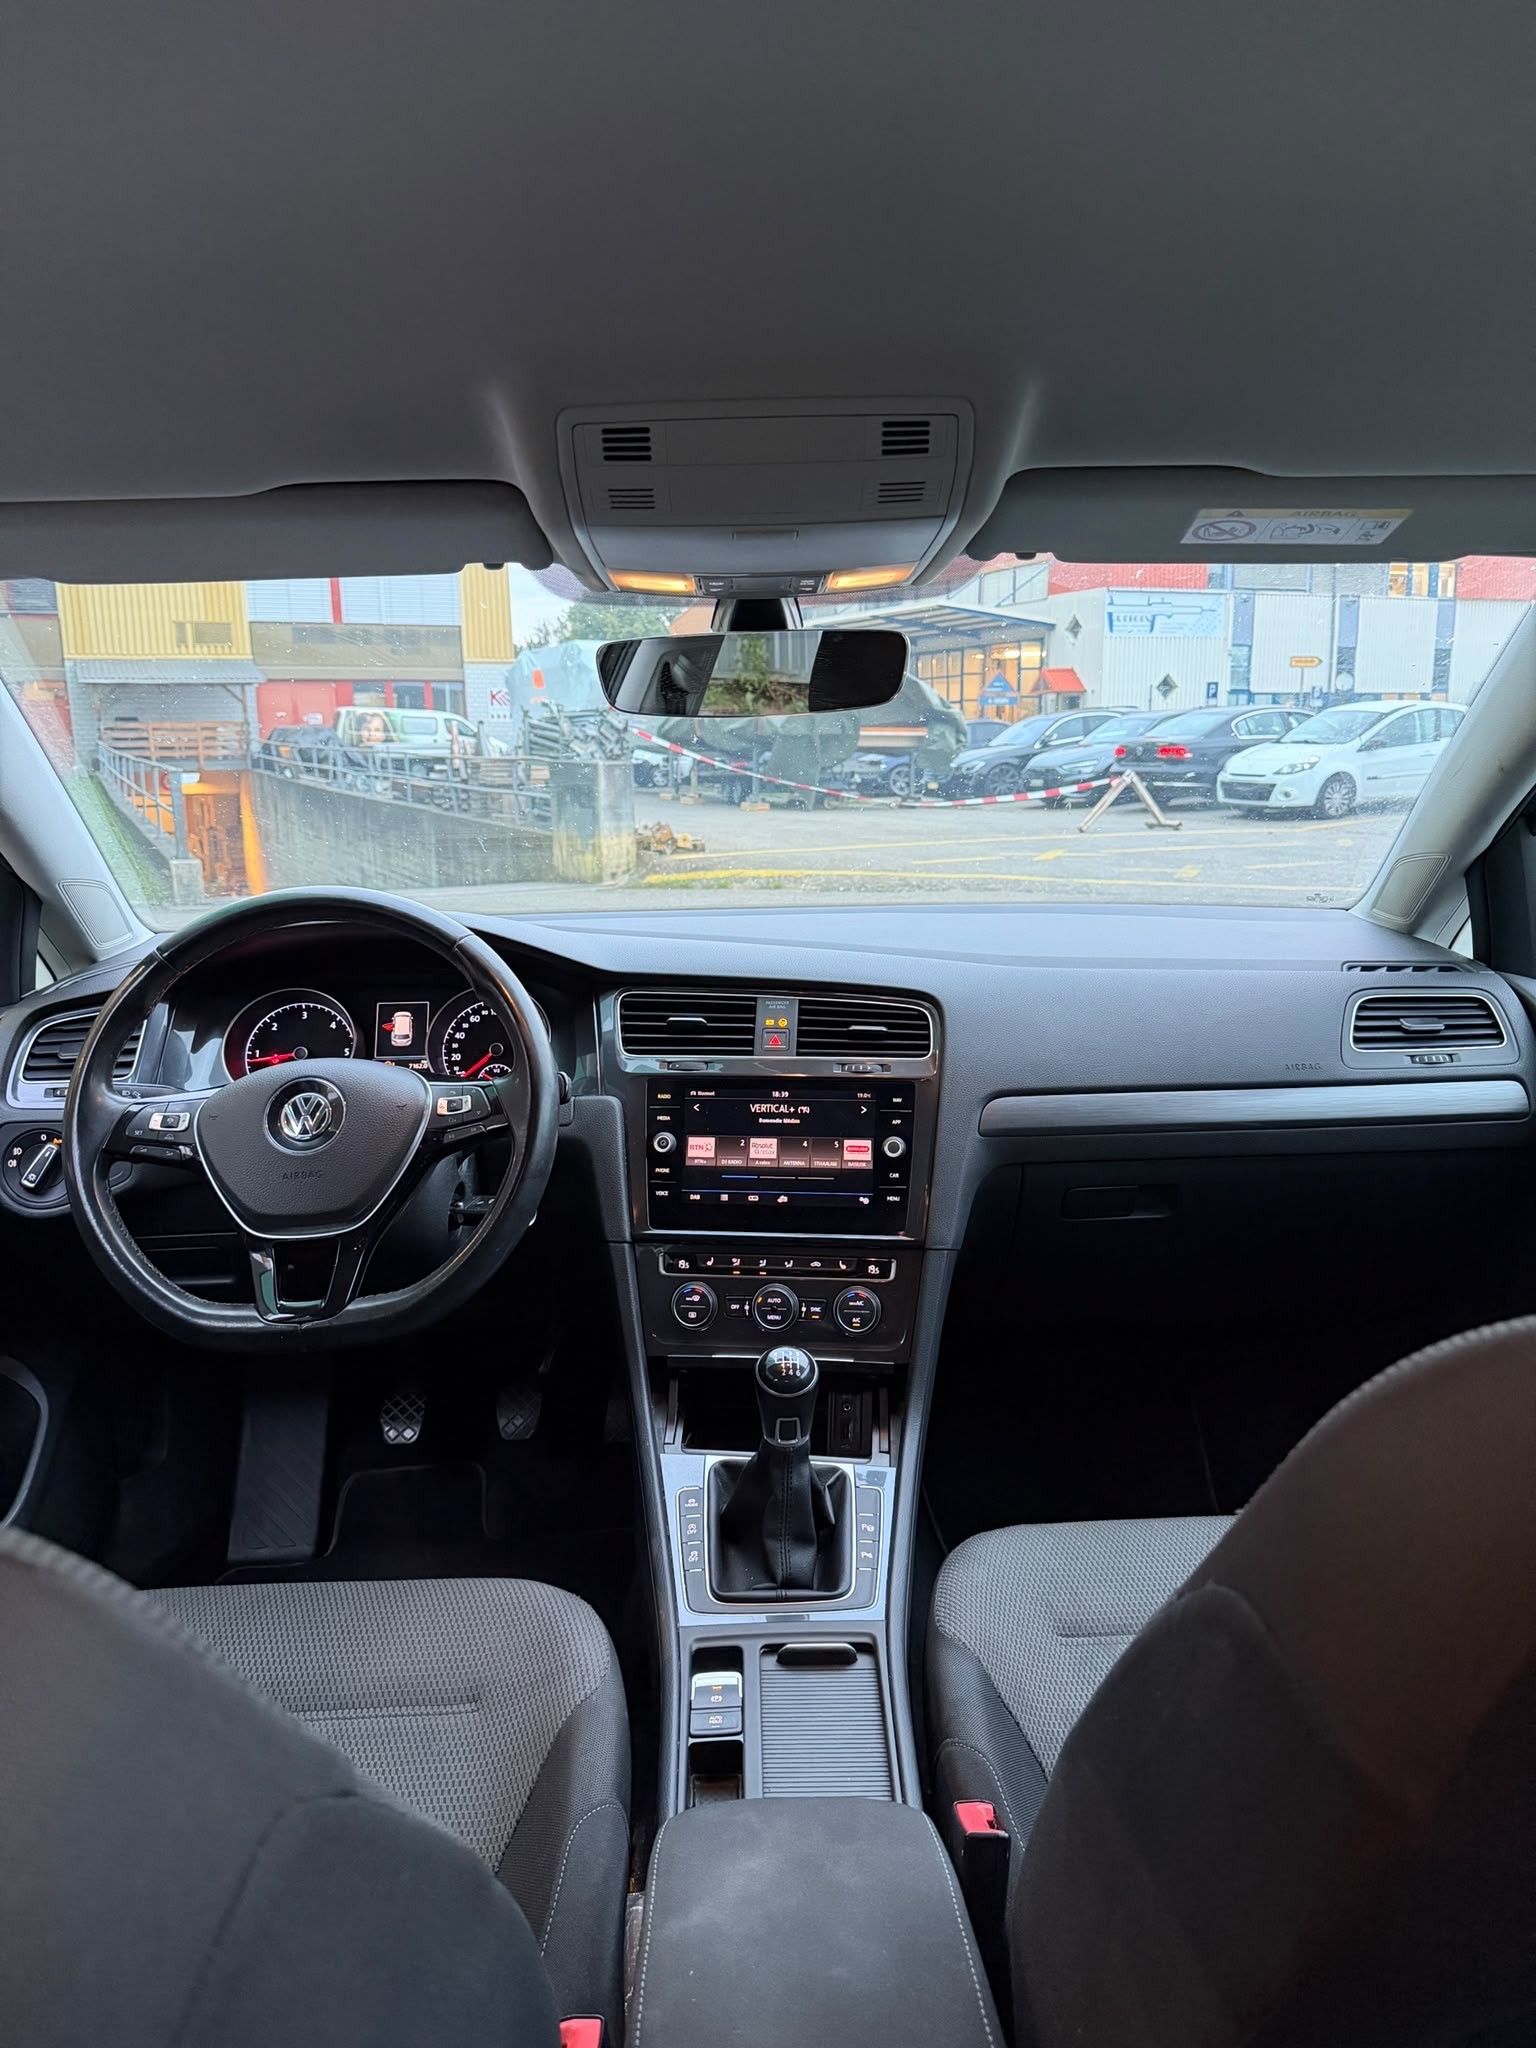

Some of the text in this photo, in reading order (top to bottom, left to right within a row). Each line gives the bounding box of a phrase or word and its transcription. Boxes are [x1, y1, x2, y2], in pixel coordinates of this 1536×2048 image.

[301, 1011, 308, 1020] 3
[469, 1015, 481, 1023] 60
[271, 1022, 278, 1031] 2
[329, 1021, 337, 1030] 4
[454, 1031, 466, 1040] 40
[255, 1049, 260, 1058] 1
[343, 1047, 350, 1057] 5
[450, 1052, 461, 1061] 20
[1285, 1062, 1321, 1071] AIRBAG
[750, 1103, 796, 1114] VERTICAL+
[740, 1139, 746, 1147] 2
[802, 1140, 808, 1148] 4
[834, 1140, 839, 1149] 5
[282, 1171, 323, 1180] AIRBAG
[795, 1369, 801, 1377] 6
